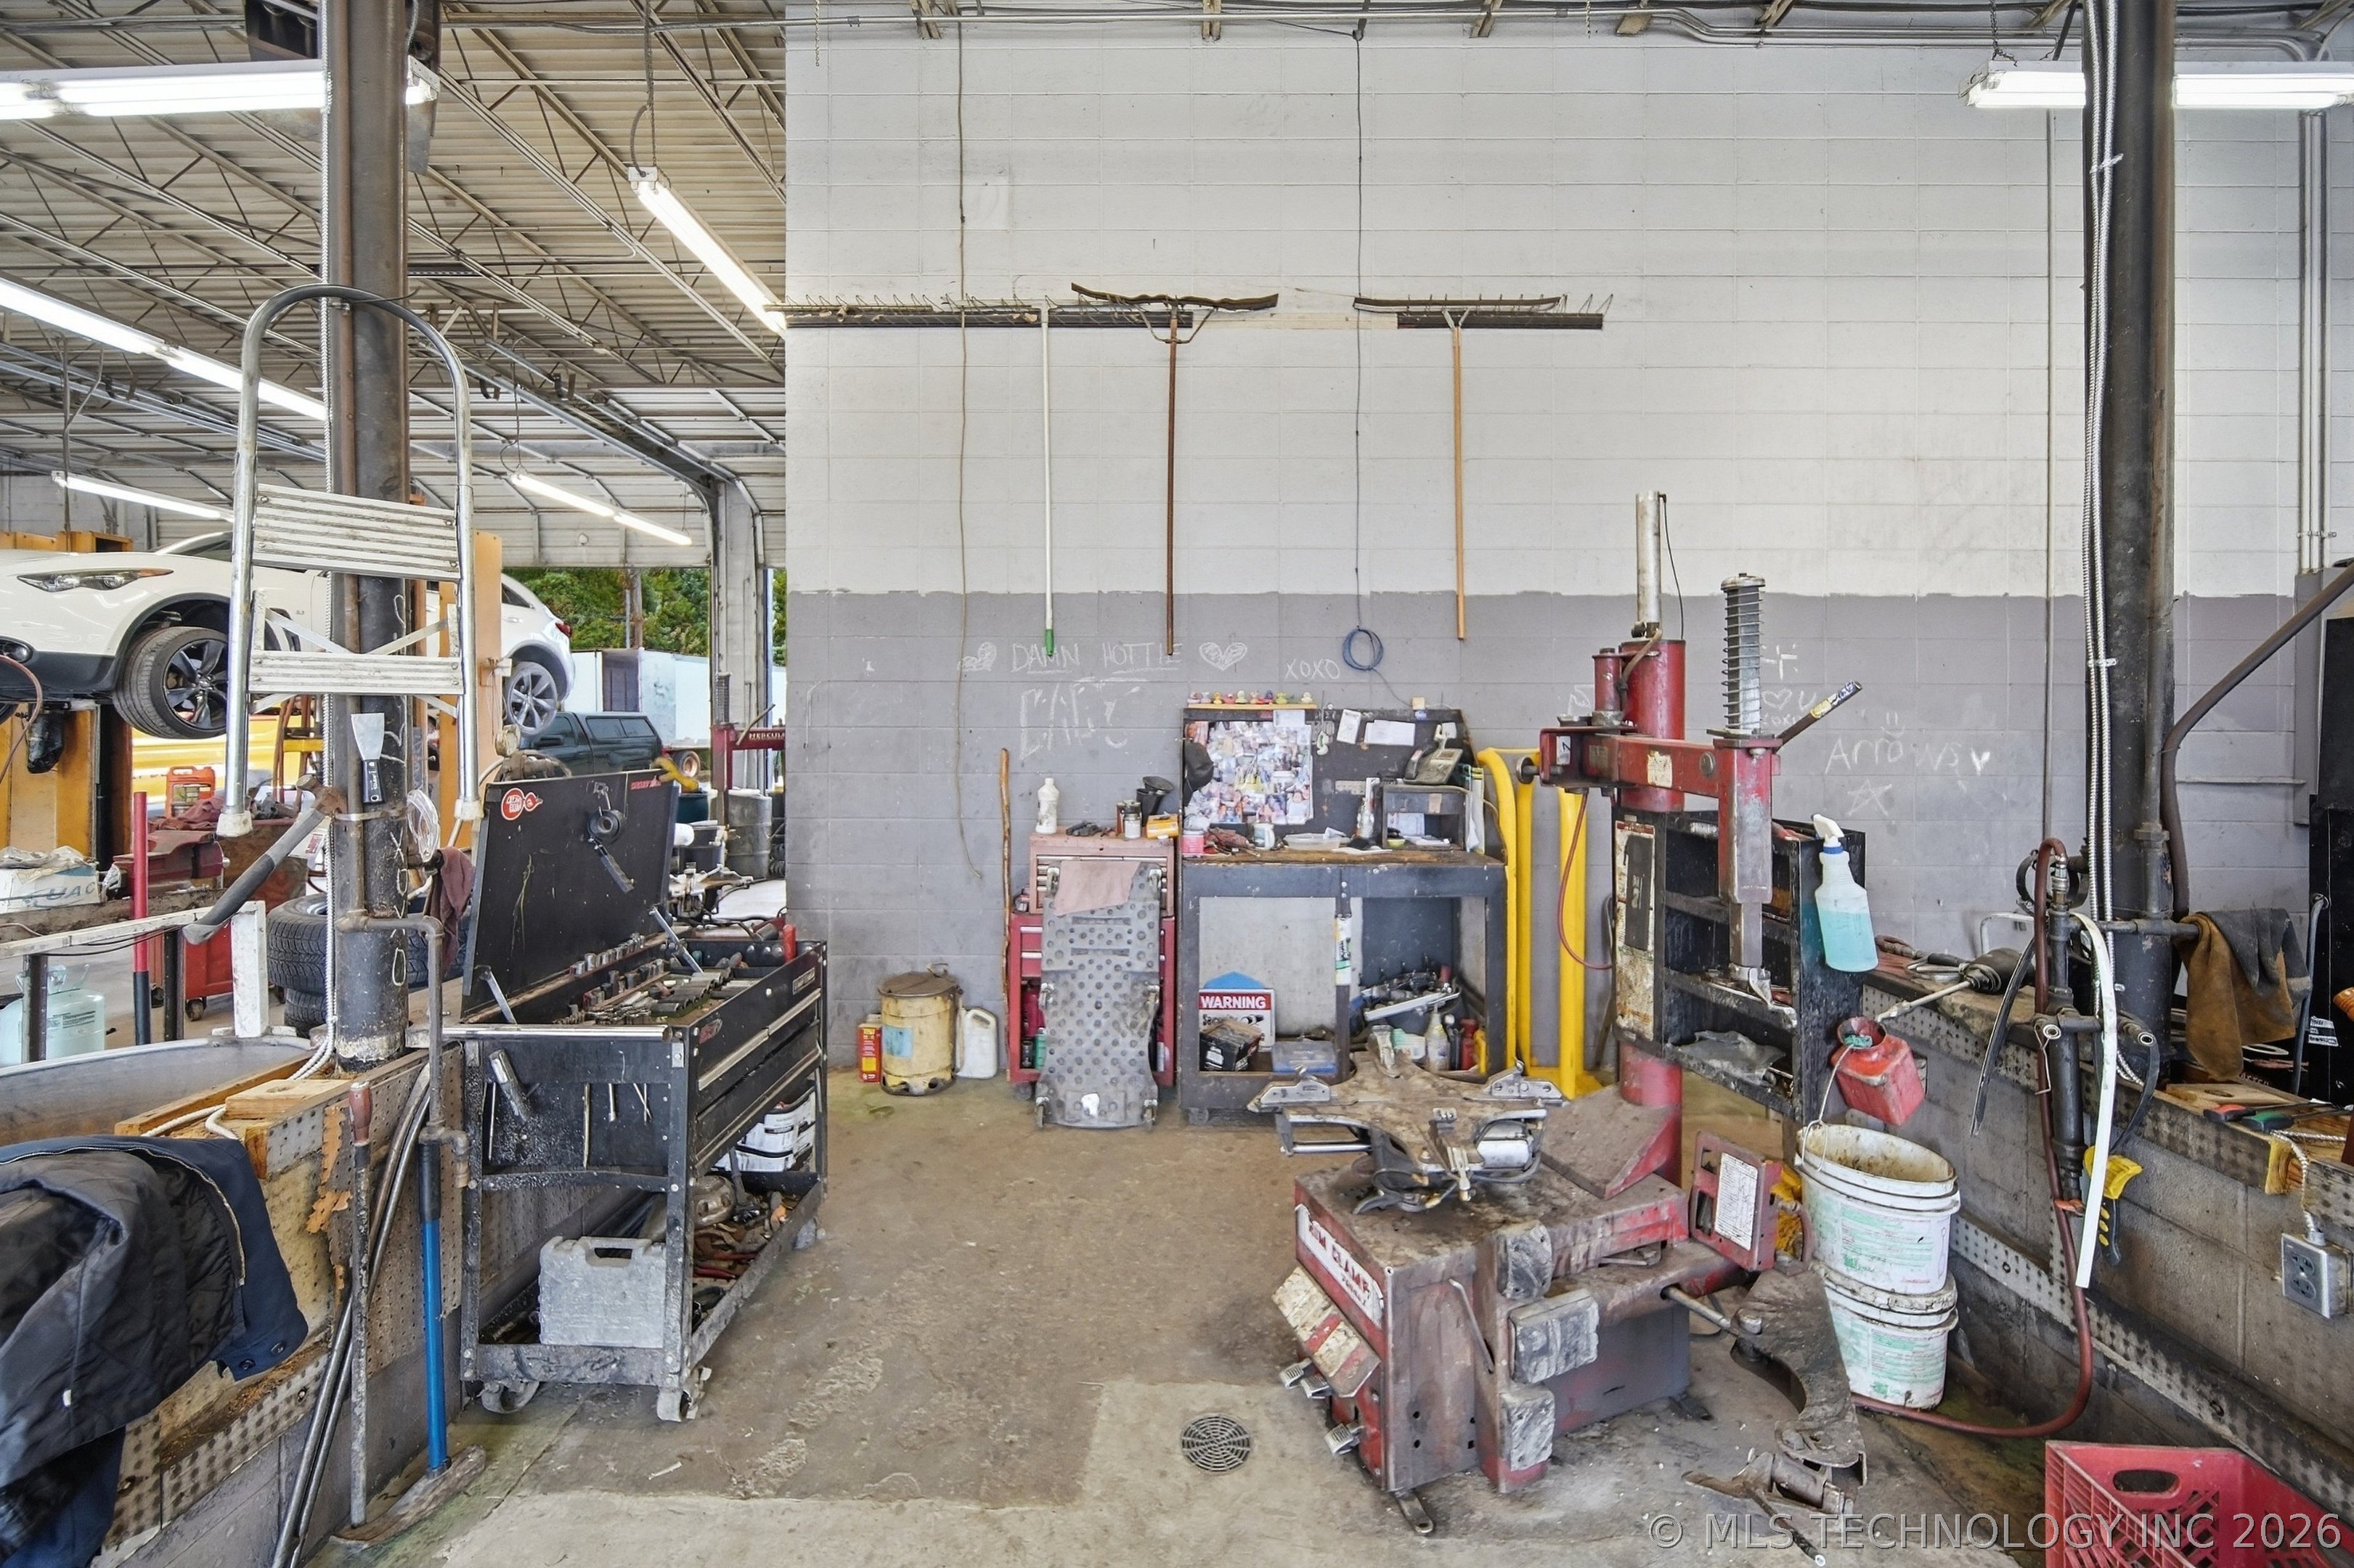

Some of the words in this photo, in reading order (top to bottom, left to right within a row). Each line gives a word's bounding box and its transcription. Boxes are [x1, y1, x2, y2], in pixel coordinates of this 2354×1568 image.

[1011, 642, 1080, 673] DAMN
[1284, 658, 1340, 680] XOXO
[1200, 995, 1266, 1009] WARNING
